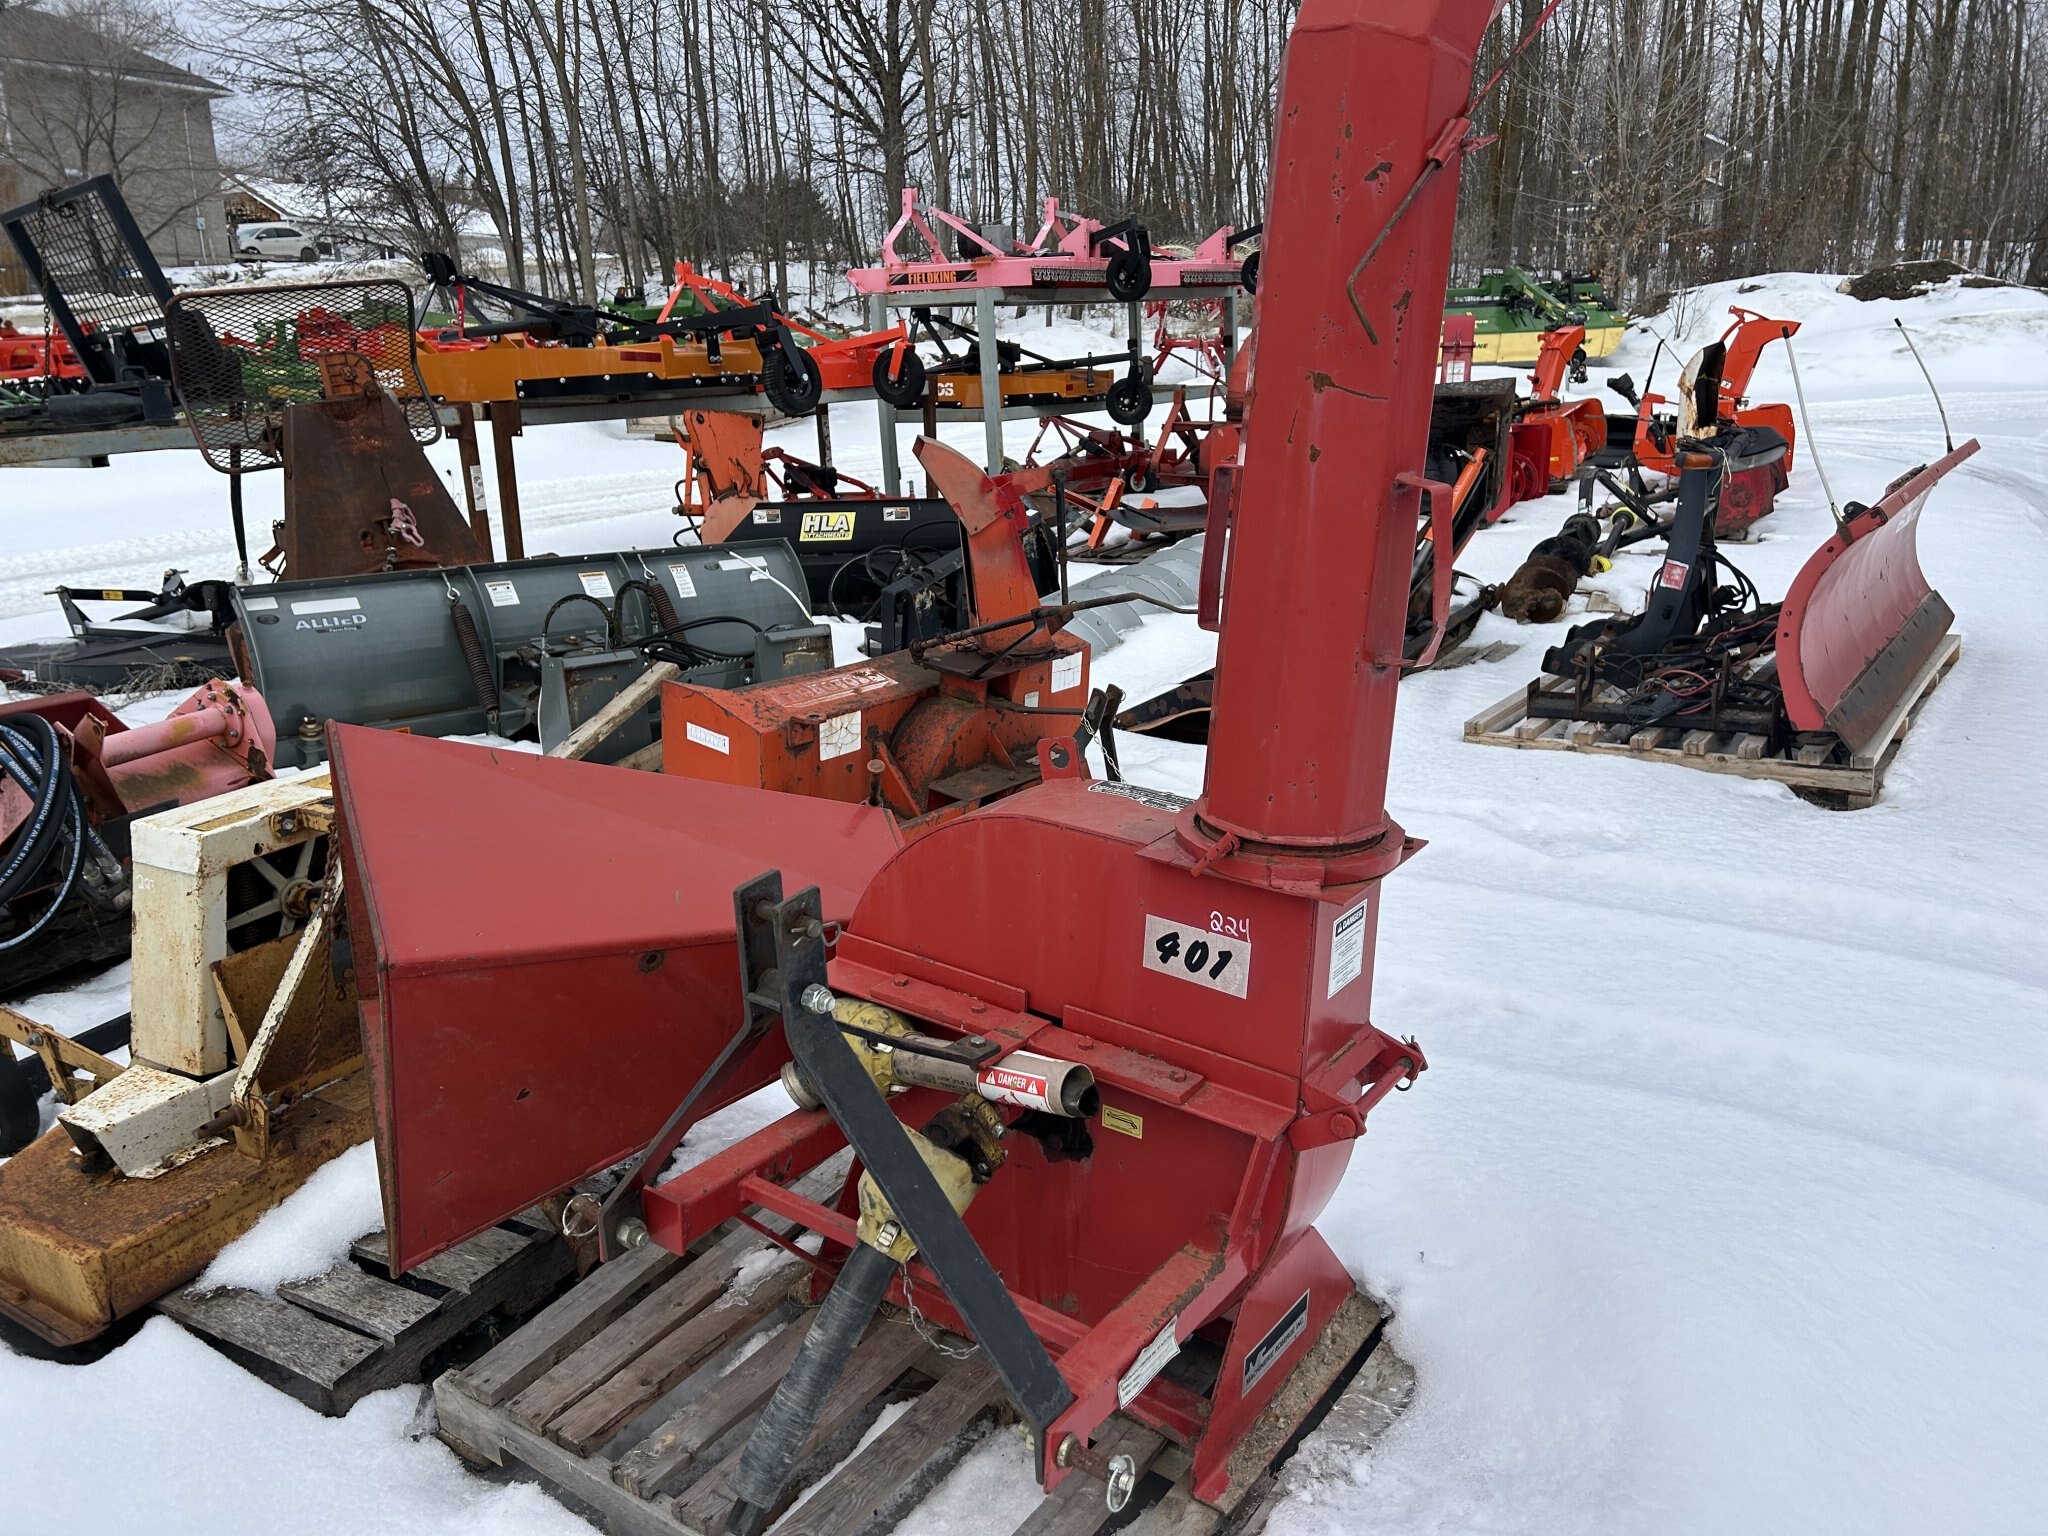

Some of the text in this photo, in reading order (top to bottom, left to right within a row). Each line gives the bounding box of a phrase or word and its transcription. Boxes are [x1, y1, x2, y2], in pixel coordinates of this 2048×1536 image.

[908, 271, 957, 285] FIELDKING
[804, 514, 850, 532] HLA
[803, 531, 850, 539] ATTACHMENTS
[23, 838, 34, 852] PSI
[1209, 910, 1250, 943] 224
[1342, 907, 1364, 930] DANGER
[1155, 931, 1233, 980] 401
[998, 1073, 1027, 1089] DANGER
